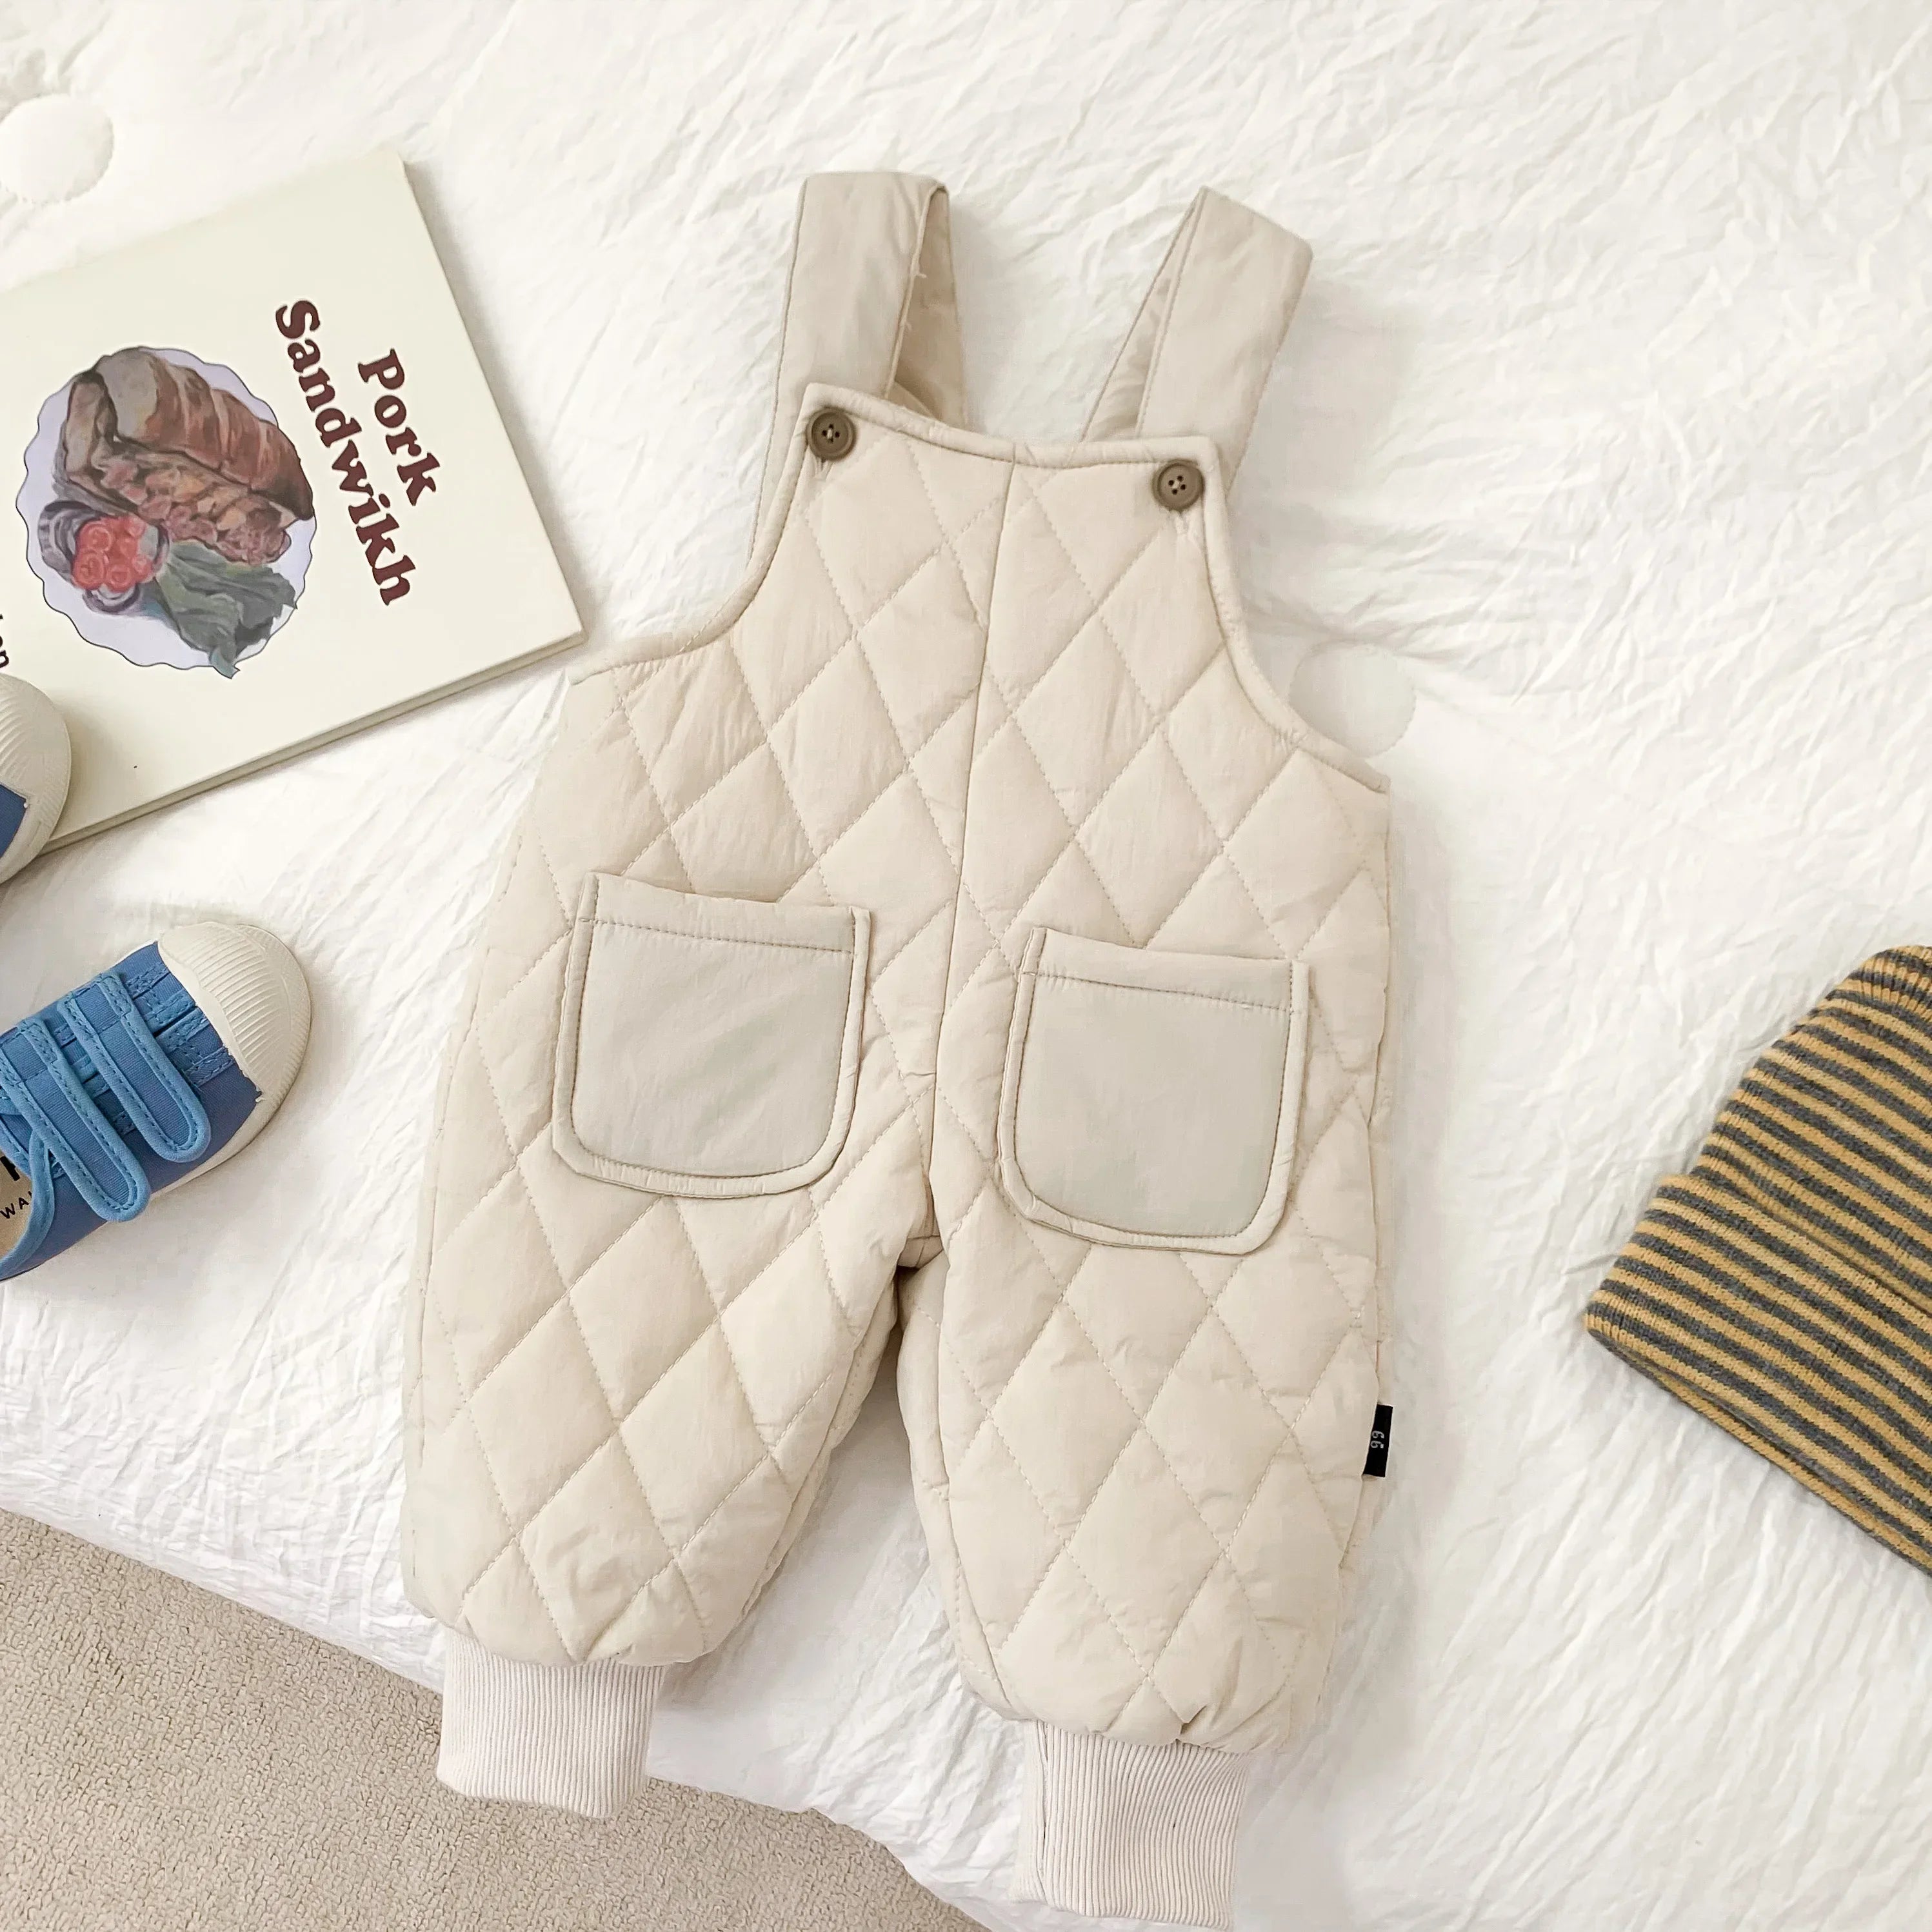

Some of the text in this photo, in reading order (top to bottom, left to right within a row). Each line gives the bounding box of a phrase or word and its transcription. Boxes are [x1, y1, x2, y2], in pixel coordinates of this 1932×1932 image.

[274, 299, 417, 607] Sandwikh
[357, 348, 441, 507] Pork
[0, 1190, 32, 1219] WA
